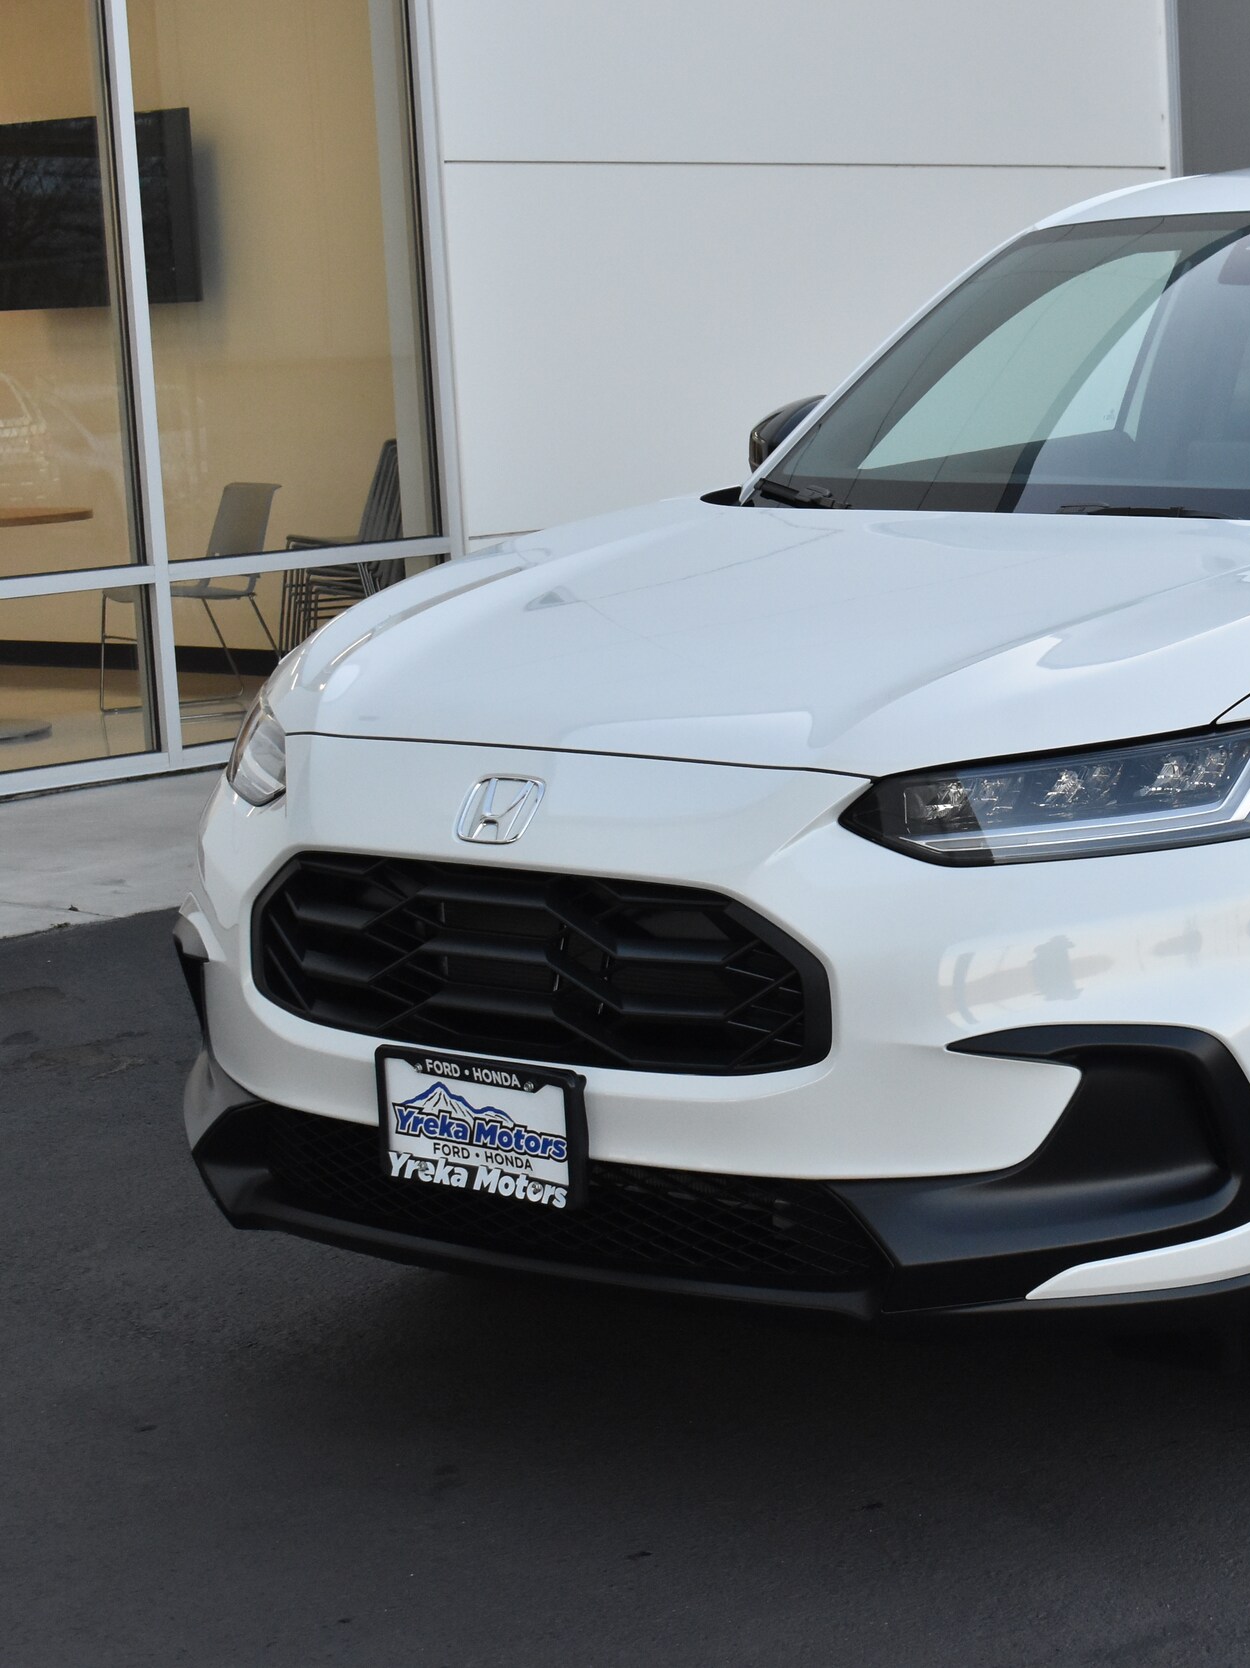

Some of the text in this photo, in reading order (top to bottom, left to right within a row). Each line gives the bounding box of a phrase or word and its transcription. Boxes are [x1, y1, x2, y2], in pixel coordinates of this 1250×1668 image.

[425, 1058, 521, 1088] FORD HONDA
[395, 1105, 567, 1159] Yreka Motors
[433, 1143, 533, 1171] FORD HONDA
[388, 1151, 567, 1209] Yreka Motors
